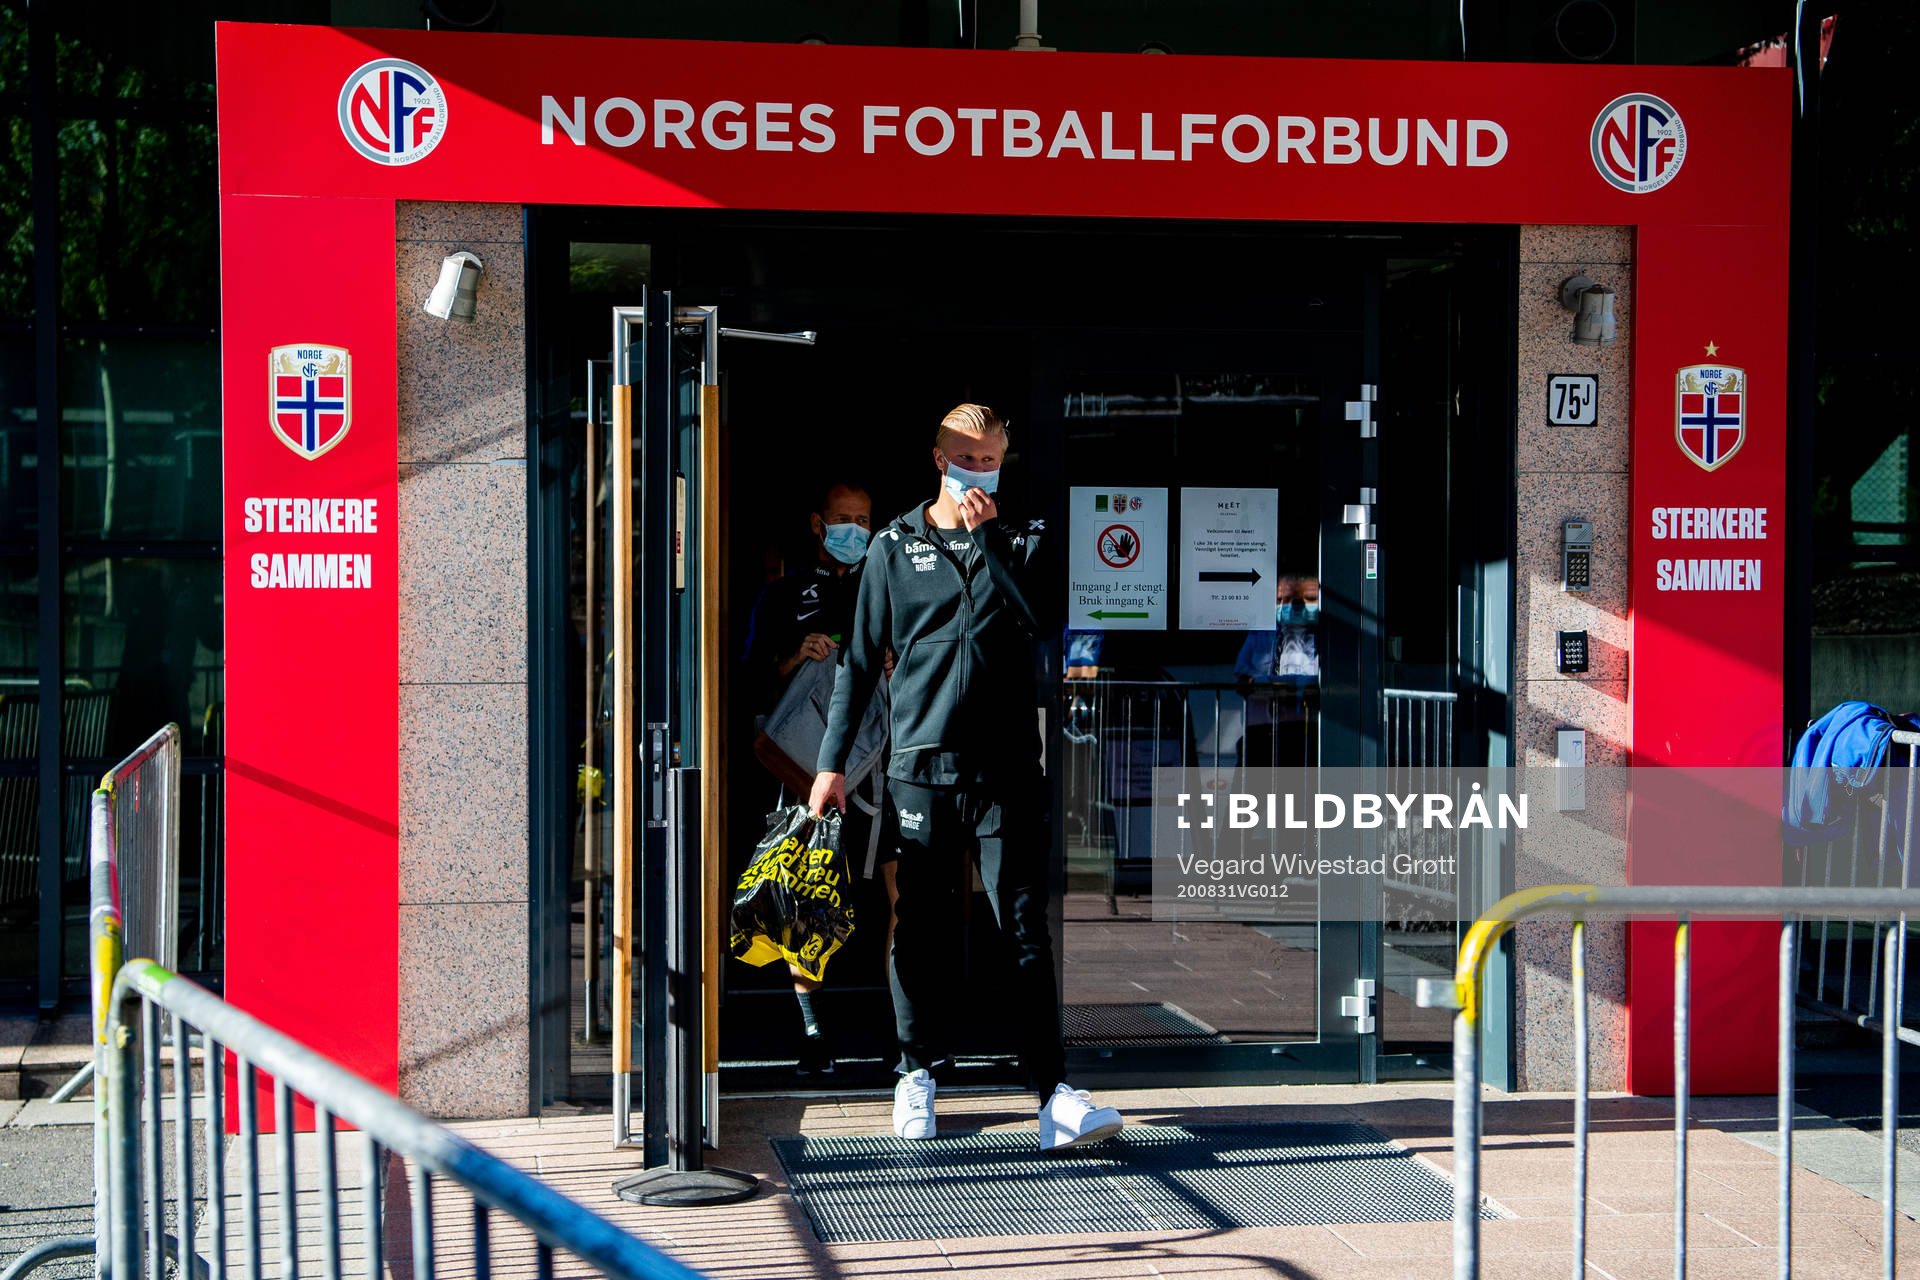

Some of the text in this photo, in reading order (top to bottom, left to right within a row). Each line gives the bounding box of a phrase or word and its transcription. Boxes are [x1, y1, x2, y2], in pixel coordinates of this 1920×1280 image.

[414, 97, 430, 105] 1902
[394, 87, 446, 163] NORGES FOTBALLFORBUND
[541, 95, 1508, 167] NORGES FOTBALLFORBUND
[1638, 119, 1685, 192] NORGES FOTBALLFORBUND
[297, 349, 322, 360] NORGE
[1700, 369, 1722, 379] NORGE
[244, 497, 378, 534] STERKERE
[1651, 507, 1767, 540] STERKERE
[250, 552, 372, 589] SAMMEN
[915, 562, 936, 572] NORGE
[1656, 558, 1761, 592] SAMMEN
[1072, 582, 1165, 594] Inngang J er stengt.
[1079, 595, 1158, 607] Bruk inngang K.
[901, 814, 920, 831] NORGE
